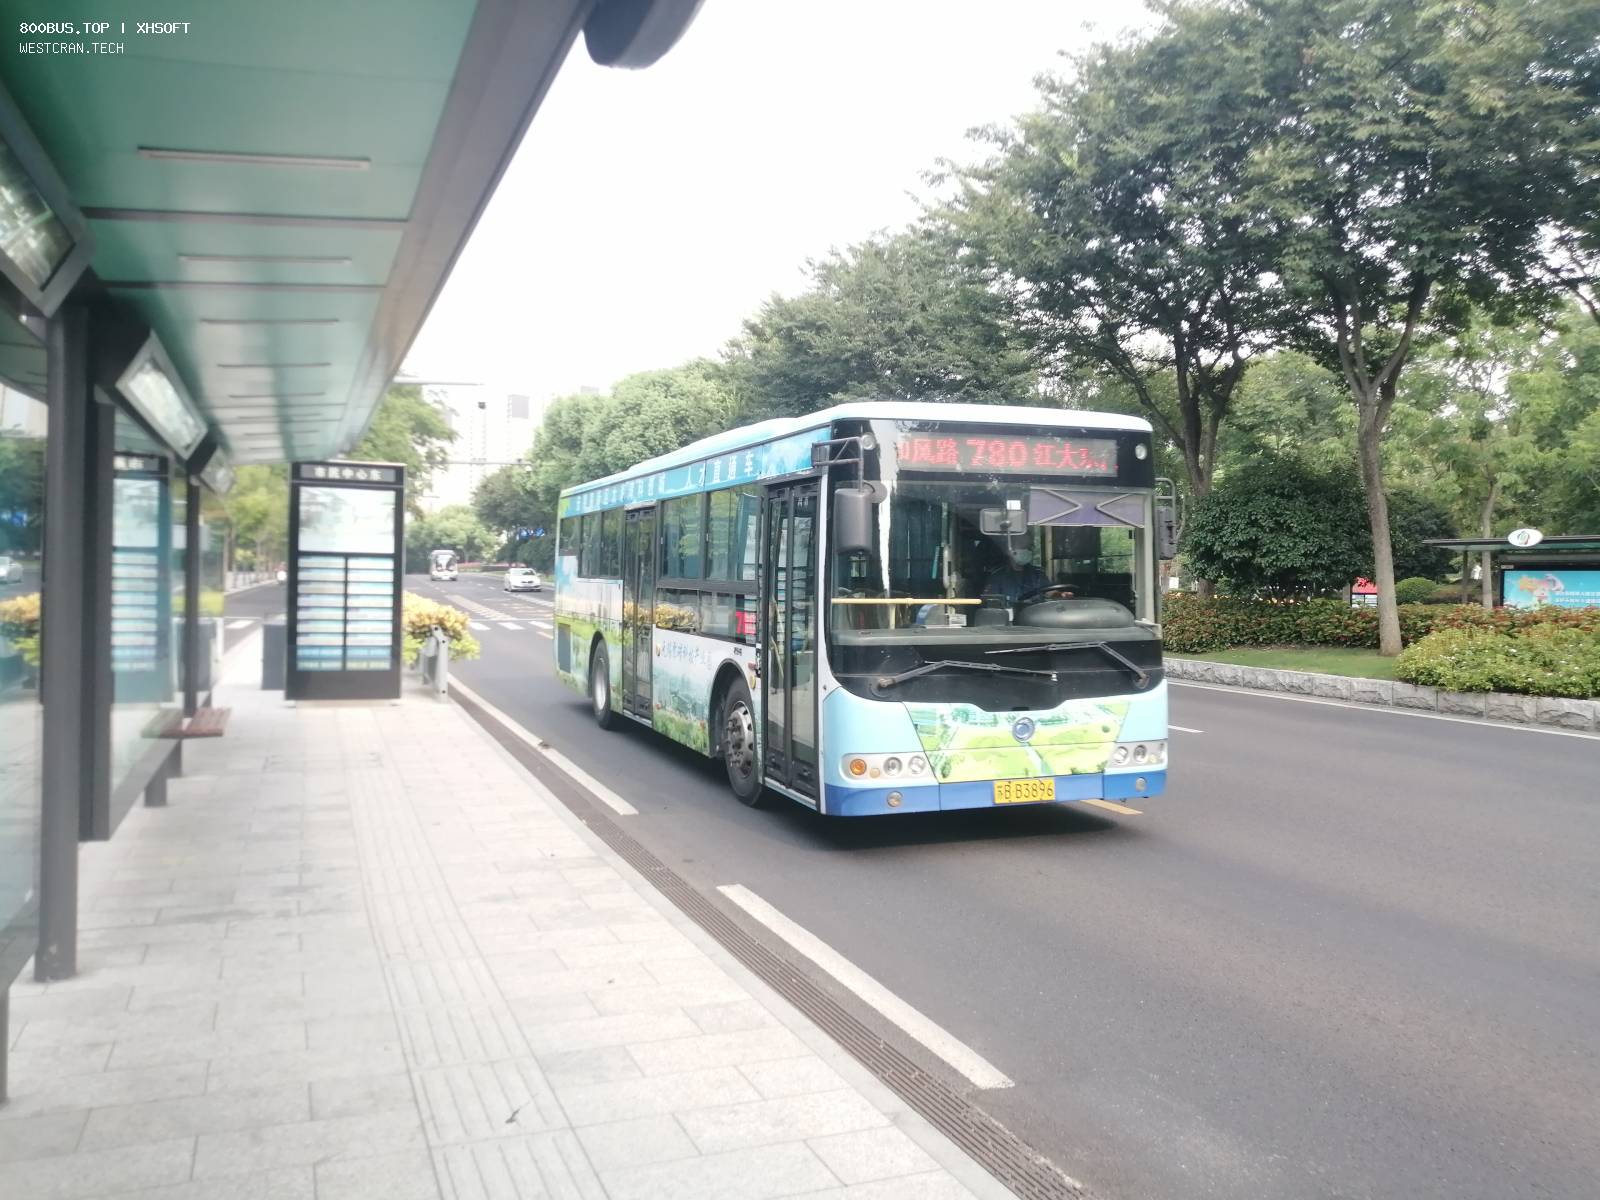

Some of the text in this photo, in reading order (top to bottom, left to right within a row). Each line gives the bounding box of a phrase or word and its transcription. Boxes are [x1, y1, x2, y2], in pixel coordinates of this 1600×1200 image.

[684, 450, 755, 489] 人才直通车
[966, 438, 1028, 468] 780
